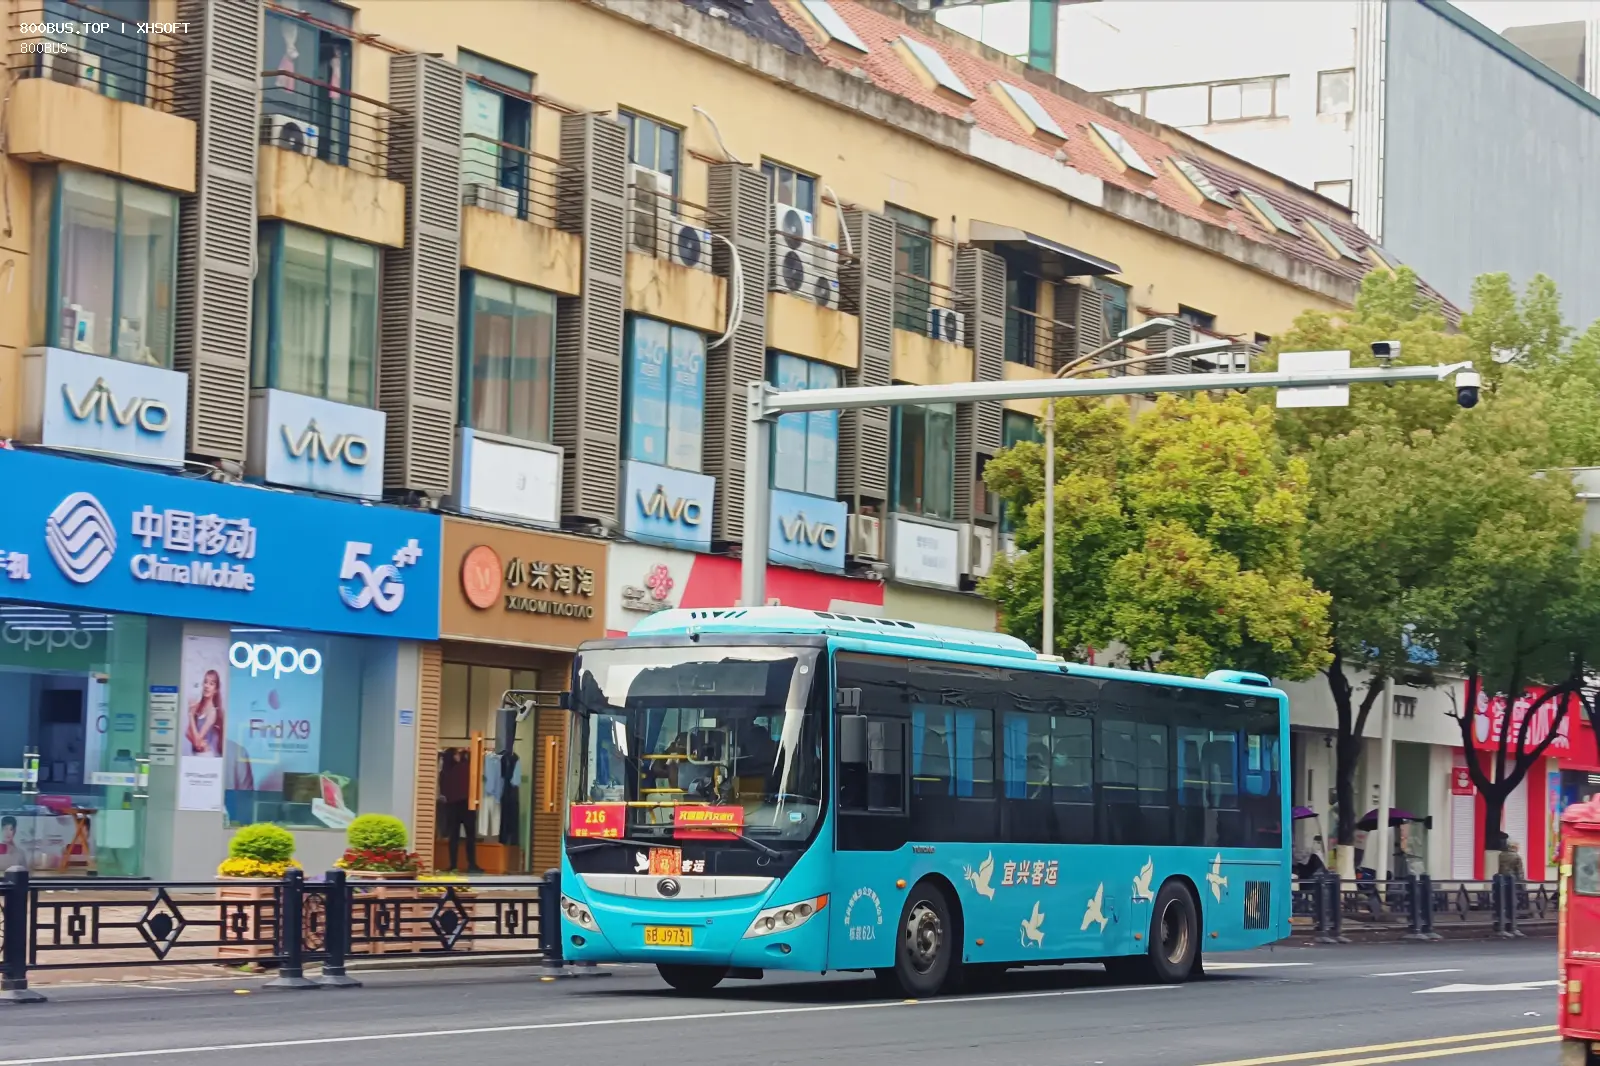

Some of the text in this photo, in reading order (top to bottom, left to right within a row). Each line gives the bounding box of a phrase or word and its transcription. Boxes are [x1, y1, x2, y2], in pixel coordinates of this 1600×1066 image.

[61, 377, 170, 433] vivo
[280, 417, 370, 467] vivo
[636, 484, 702, 526] vivo
[131, 505, 256, 559] 中国移动
[778, 510, 838, 550] vivo
[130, 553, 255, 592] China Mobile
[229, 641, 322, 680] oppo
[249, 718, 311, 740] Find X9
[585, 810, 606, 824] 216
[682, 859, 705, 873] 客运
[1001, 860, 1059, 887] 宜兴客运
